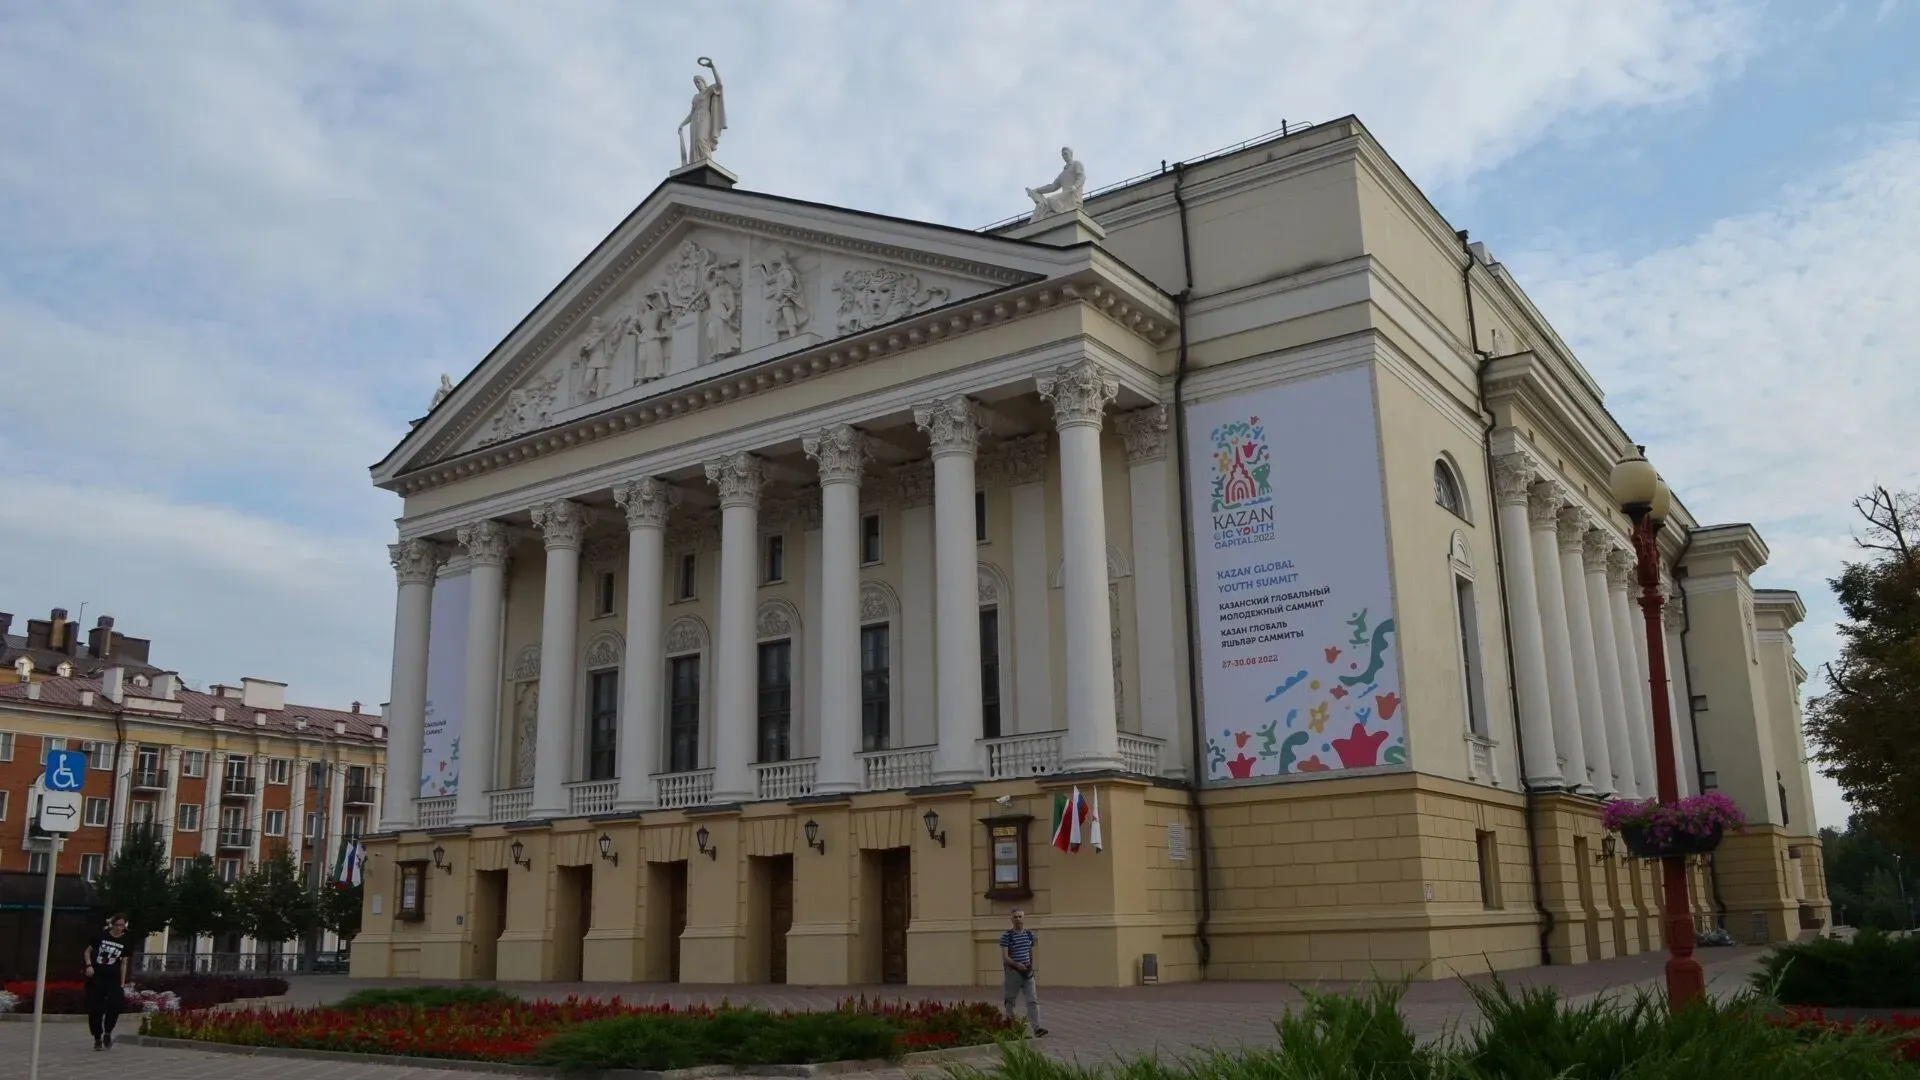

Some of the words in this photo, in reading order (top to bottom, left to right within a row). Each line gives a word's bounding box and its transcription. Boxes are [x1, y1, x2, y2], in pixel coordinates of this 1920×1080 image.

[1213, 505, 1274, 530] KAZAN
[1236, 523, 1274, 536] YOUTH
[1214, 537, 1253, 549] CAPITAL
[1253, 532, 1275, 543] 2022
[1217, 566, 1251, 580] KAZAN
[1253, 559, 1295, 574] GLOBAL
[1218, 581, 1253, 593] YOUTH
[1256, 573, 1298, 587] SUMMIT
[1219, 596, 1269, 611] КАЗАНСКИЙ
[1271, 585, 1331, 602] ГЛОБАЛЬНЫЙ
[1220, 605, 1284, 621] МОЛОДЕЖНЫЙ
[1285, 600, 1324, 612] САММИТ
[1220, 626, 1247, 637] КАЗАН
[1249, 621, 1288, 633] ГЛОБАЛЬ
[1258, 630, 1304, 643] САММИТЫ
[1258, 654, 1279, 664] 2022
